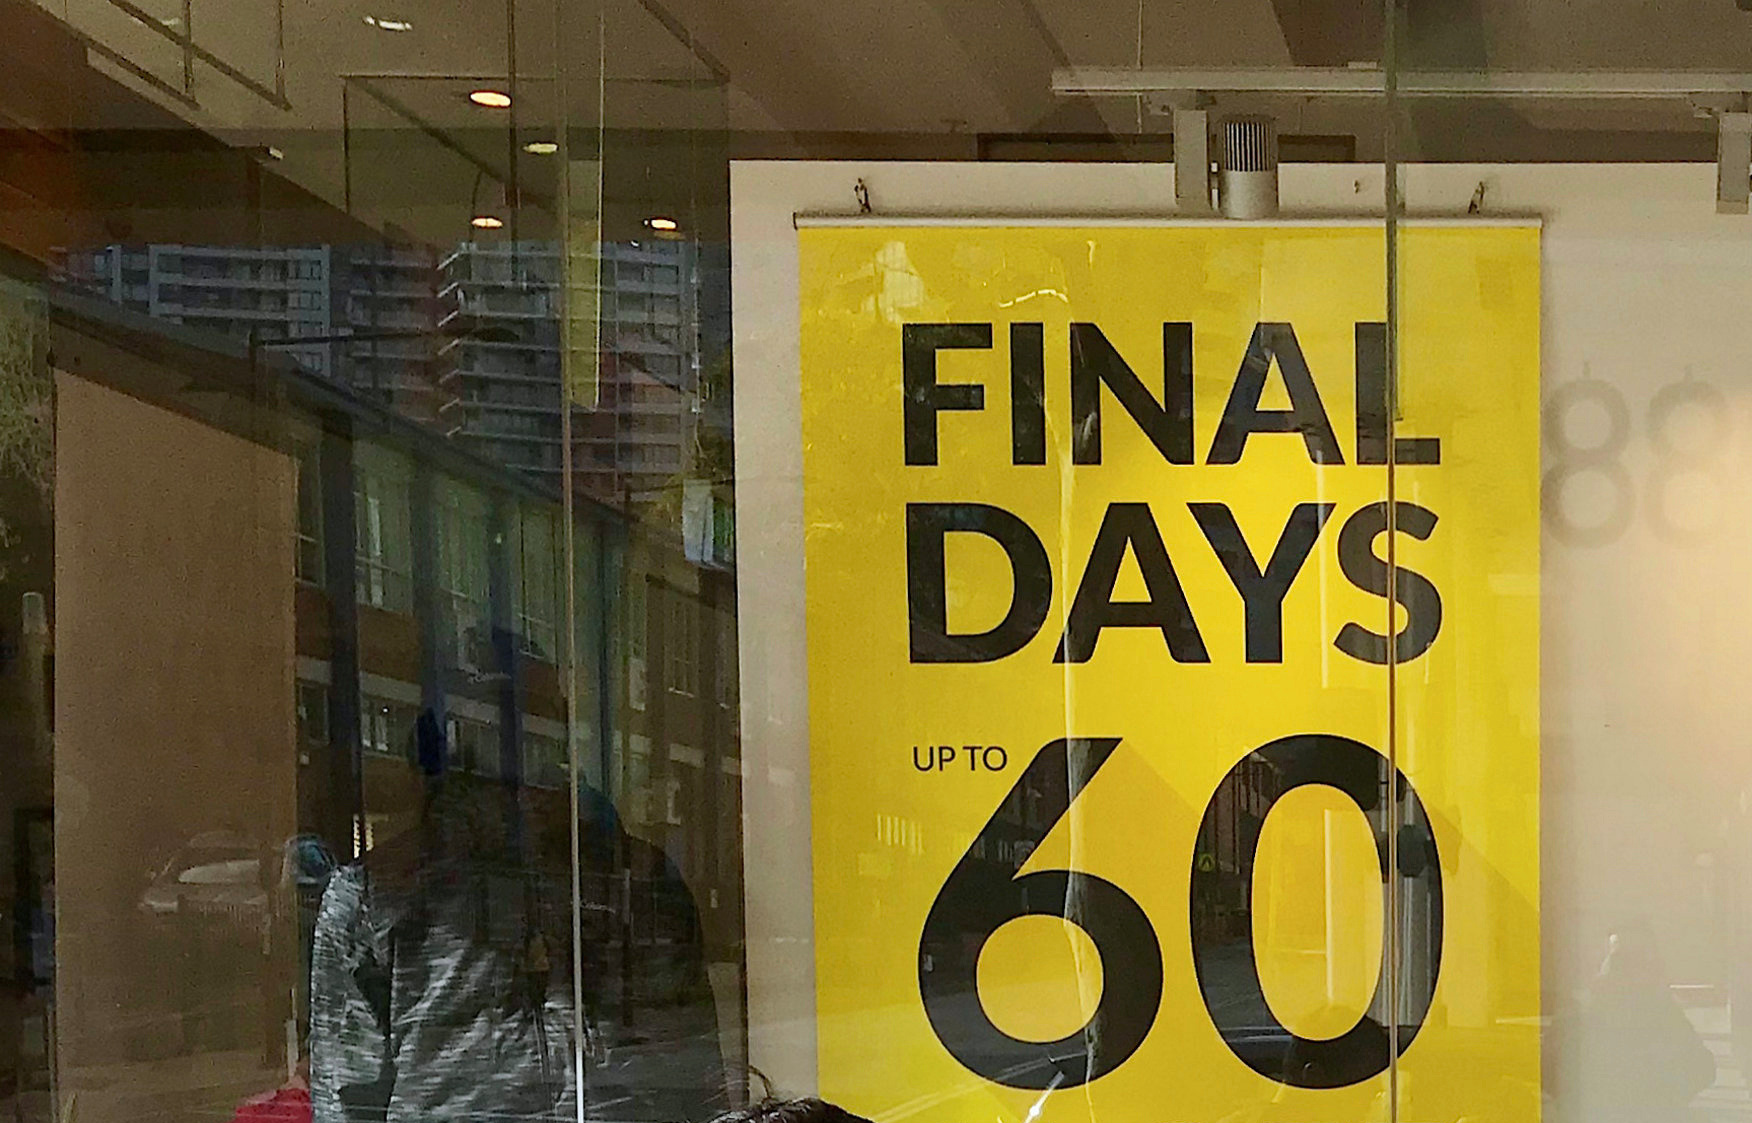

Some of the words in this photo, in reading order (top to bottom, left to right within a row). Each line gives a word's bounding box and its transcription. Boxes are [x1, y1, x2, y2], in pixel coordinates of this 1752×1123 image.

[902, 321, 1441, 466] FINAL
[908, 501, 1443, 666] DAYS
[912, 745, 956, 772] UP
[963, 745, 1008, 772] TO
[917, 732, 1445, 1090] 60
